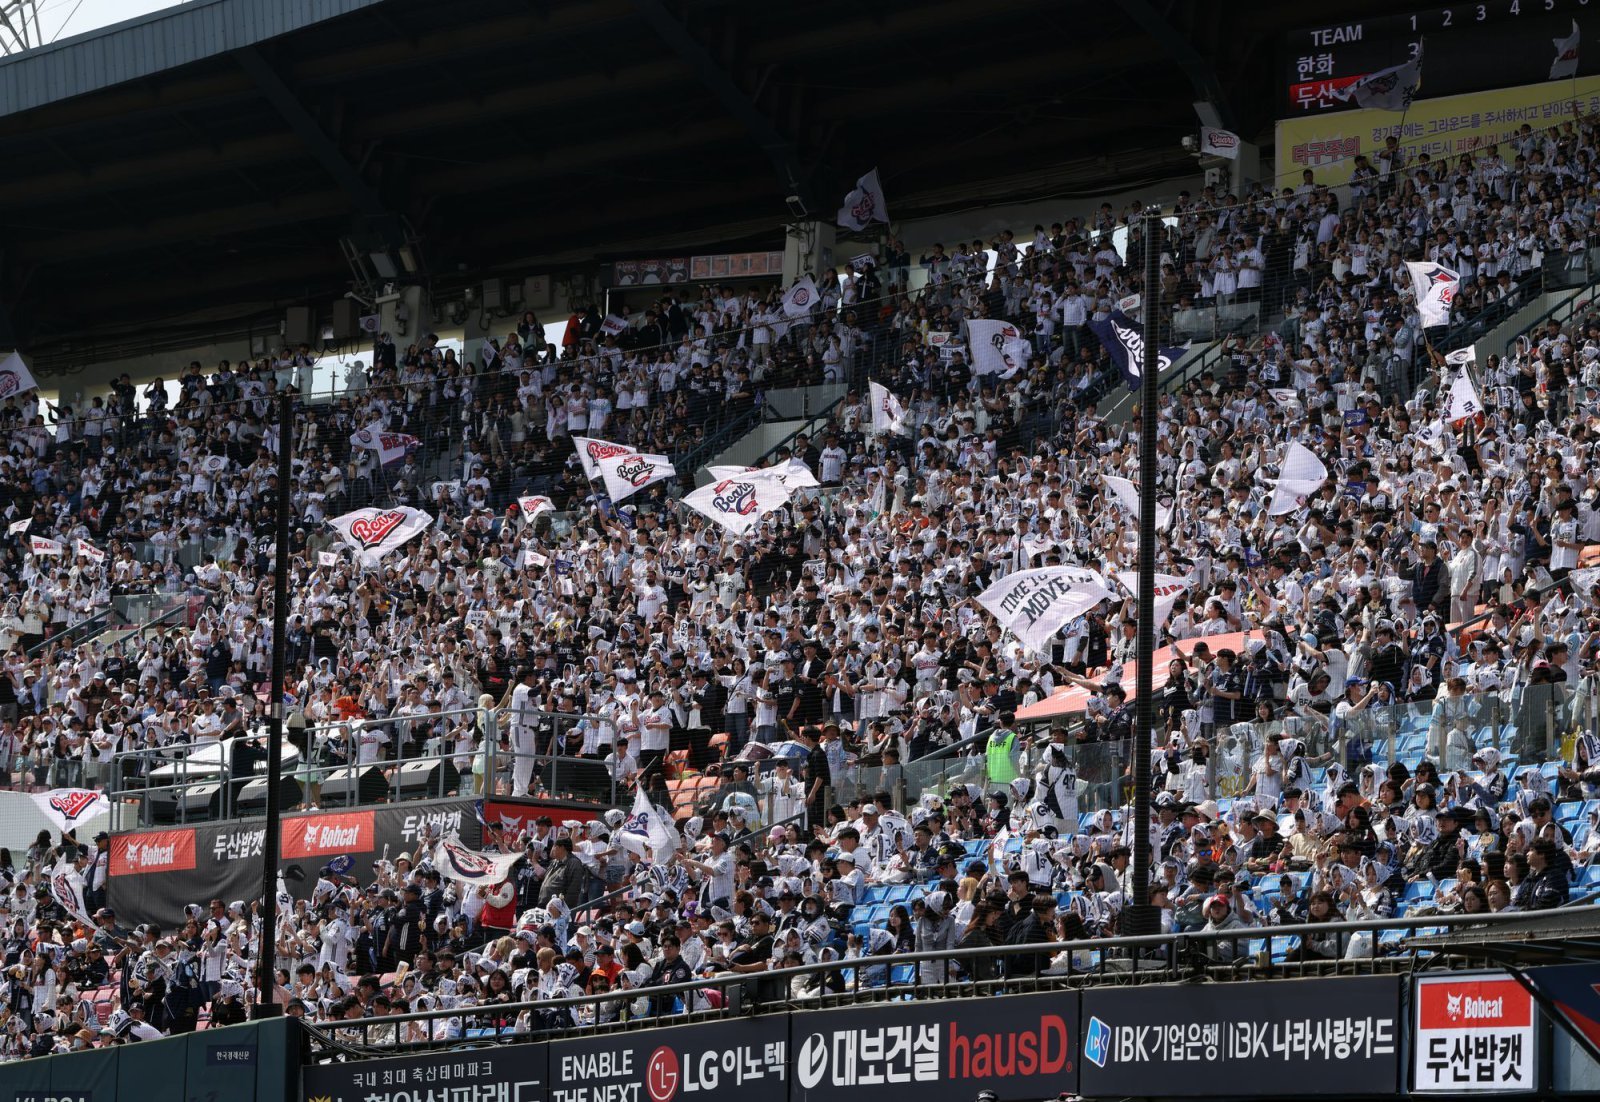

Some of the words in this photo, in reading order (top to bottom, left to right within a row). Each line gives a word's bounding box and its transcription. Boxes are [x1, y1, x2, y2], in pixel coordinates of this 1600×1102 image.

[1311, 25, 1363, 47] TEAM
[1410, 15, 1417, 31] 1
[1442, 10, 1452, 27] 2
[1476, 5, 1486, 21] 3
[1510, 0, 1520, 15] 4
[1297, 53, 1335, 81] 한화
[1297, 83, 1335, 109] 두산
[1428, 112, 1481, 134] 그라운드를
[713, 483, 756, 512] Bears
[352, 510, 408, 546] Bears
[1000, 580, 1032, 615] TIME
[1018, 576, 1071, 622] MOVE
[1063, 774, 1075, 790] 47
[213, 830, 265, 860] 두산밥캣
[319, 823, 360, 848] Bobcat
[141, 843, 174, 867] Bobcat
[1464, 996, 1503, 1019] Bobcat
[562, 1050, 633, 1082] ENABLE
[832, 1023, 940, 1087] 대보건설
[1426, 1033, 1523, 1083] 두산밥캣
[353, 1073, 377, 1088] 국내
[383, 1068, 407, 1086] 최대
[412, 1061, 493, 1083] 축산테마파크
[594, 1082, 642, 1102] NEXT
